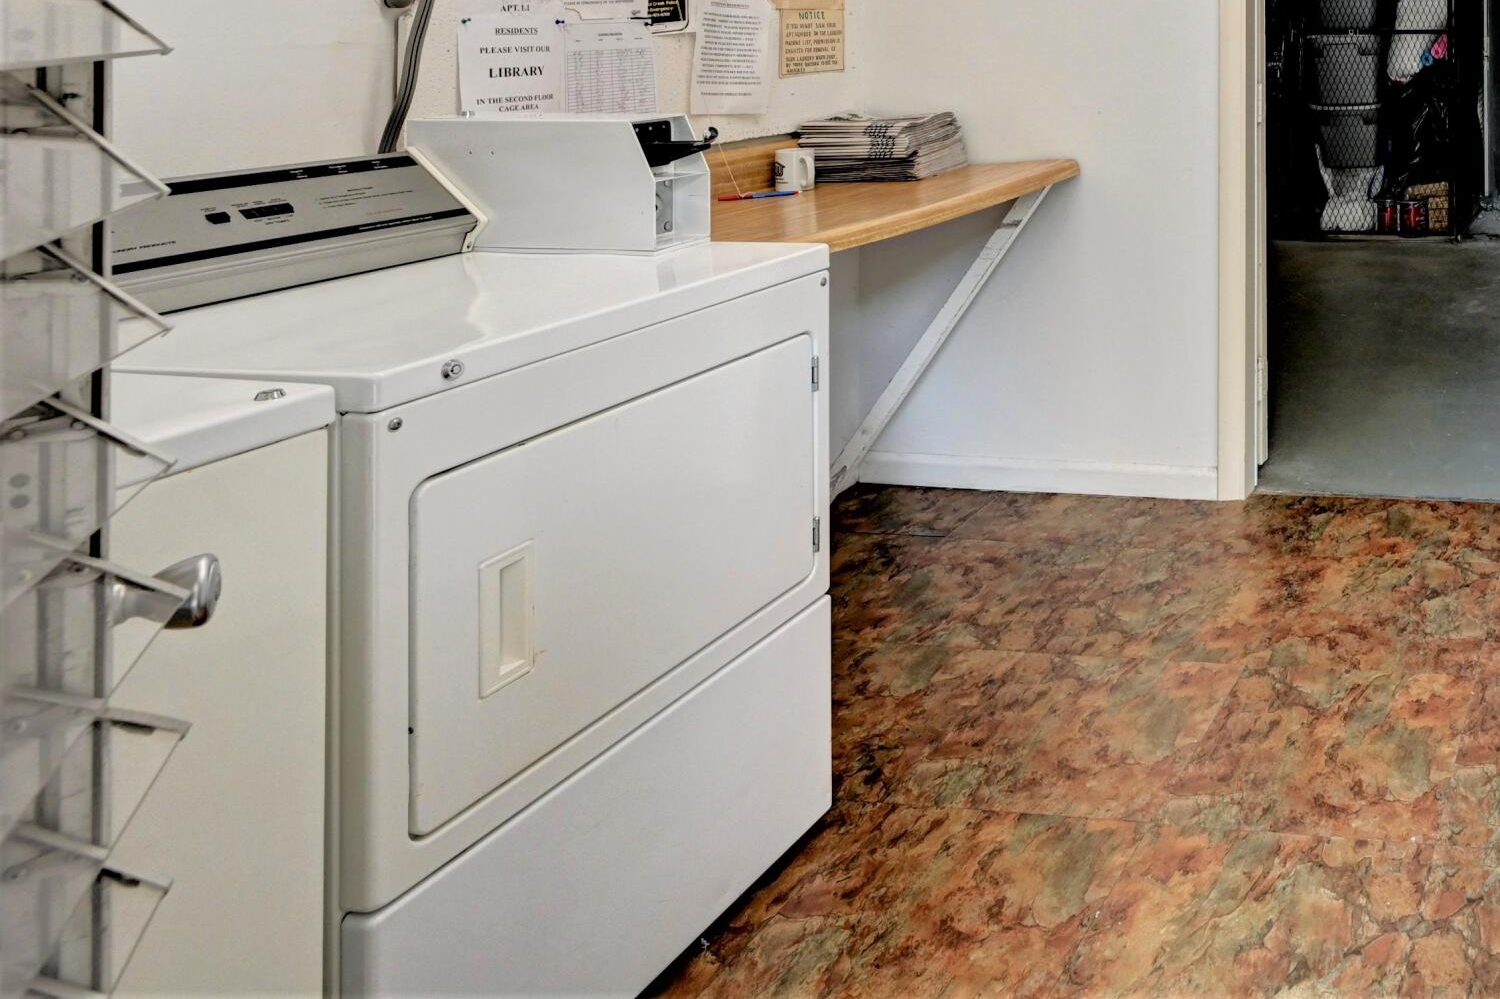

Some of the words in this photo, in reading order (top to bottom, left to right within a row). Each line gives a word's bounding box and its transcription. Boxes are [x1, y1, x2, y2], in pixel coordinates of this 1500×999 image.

[500, 4, 520, 12] APT.
[798, 11, 825, 20] NOTICE
[495, 27, 538, 35] RESIDENTS
[479, 46, 513, 54] PLEASE
[514, 45, 535, 53] VISIT
[535, 45, 551, 53] OUR
[489, 65, 545, 78] LIBRARY
[487, 97, 504, 105] THE
[504, 95, 533, 103] SECOND
[534, 93, 554, 101] FLOOR
[498, 104, 518, 112] CAGE
[519, 103, 539, 111] AREA
